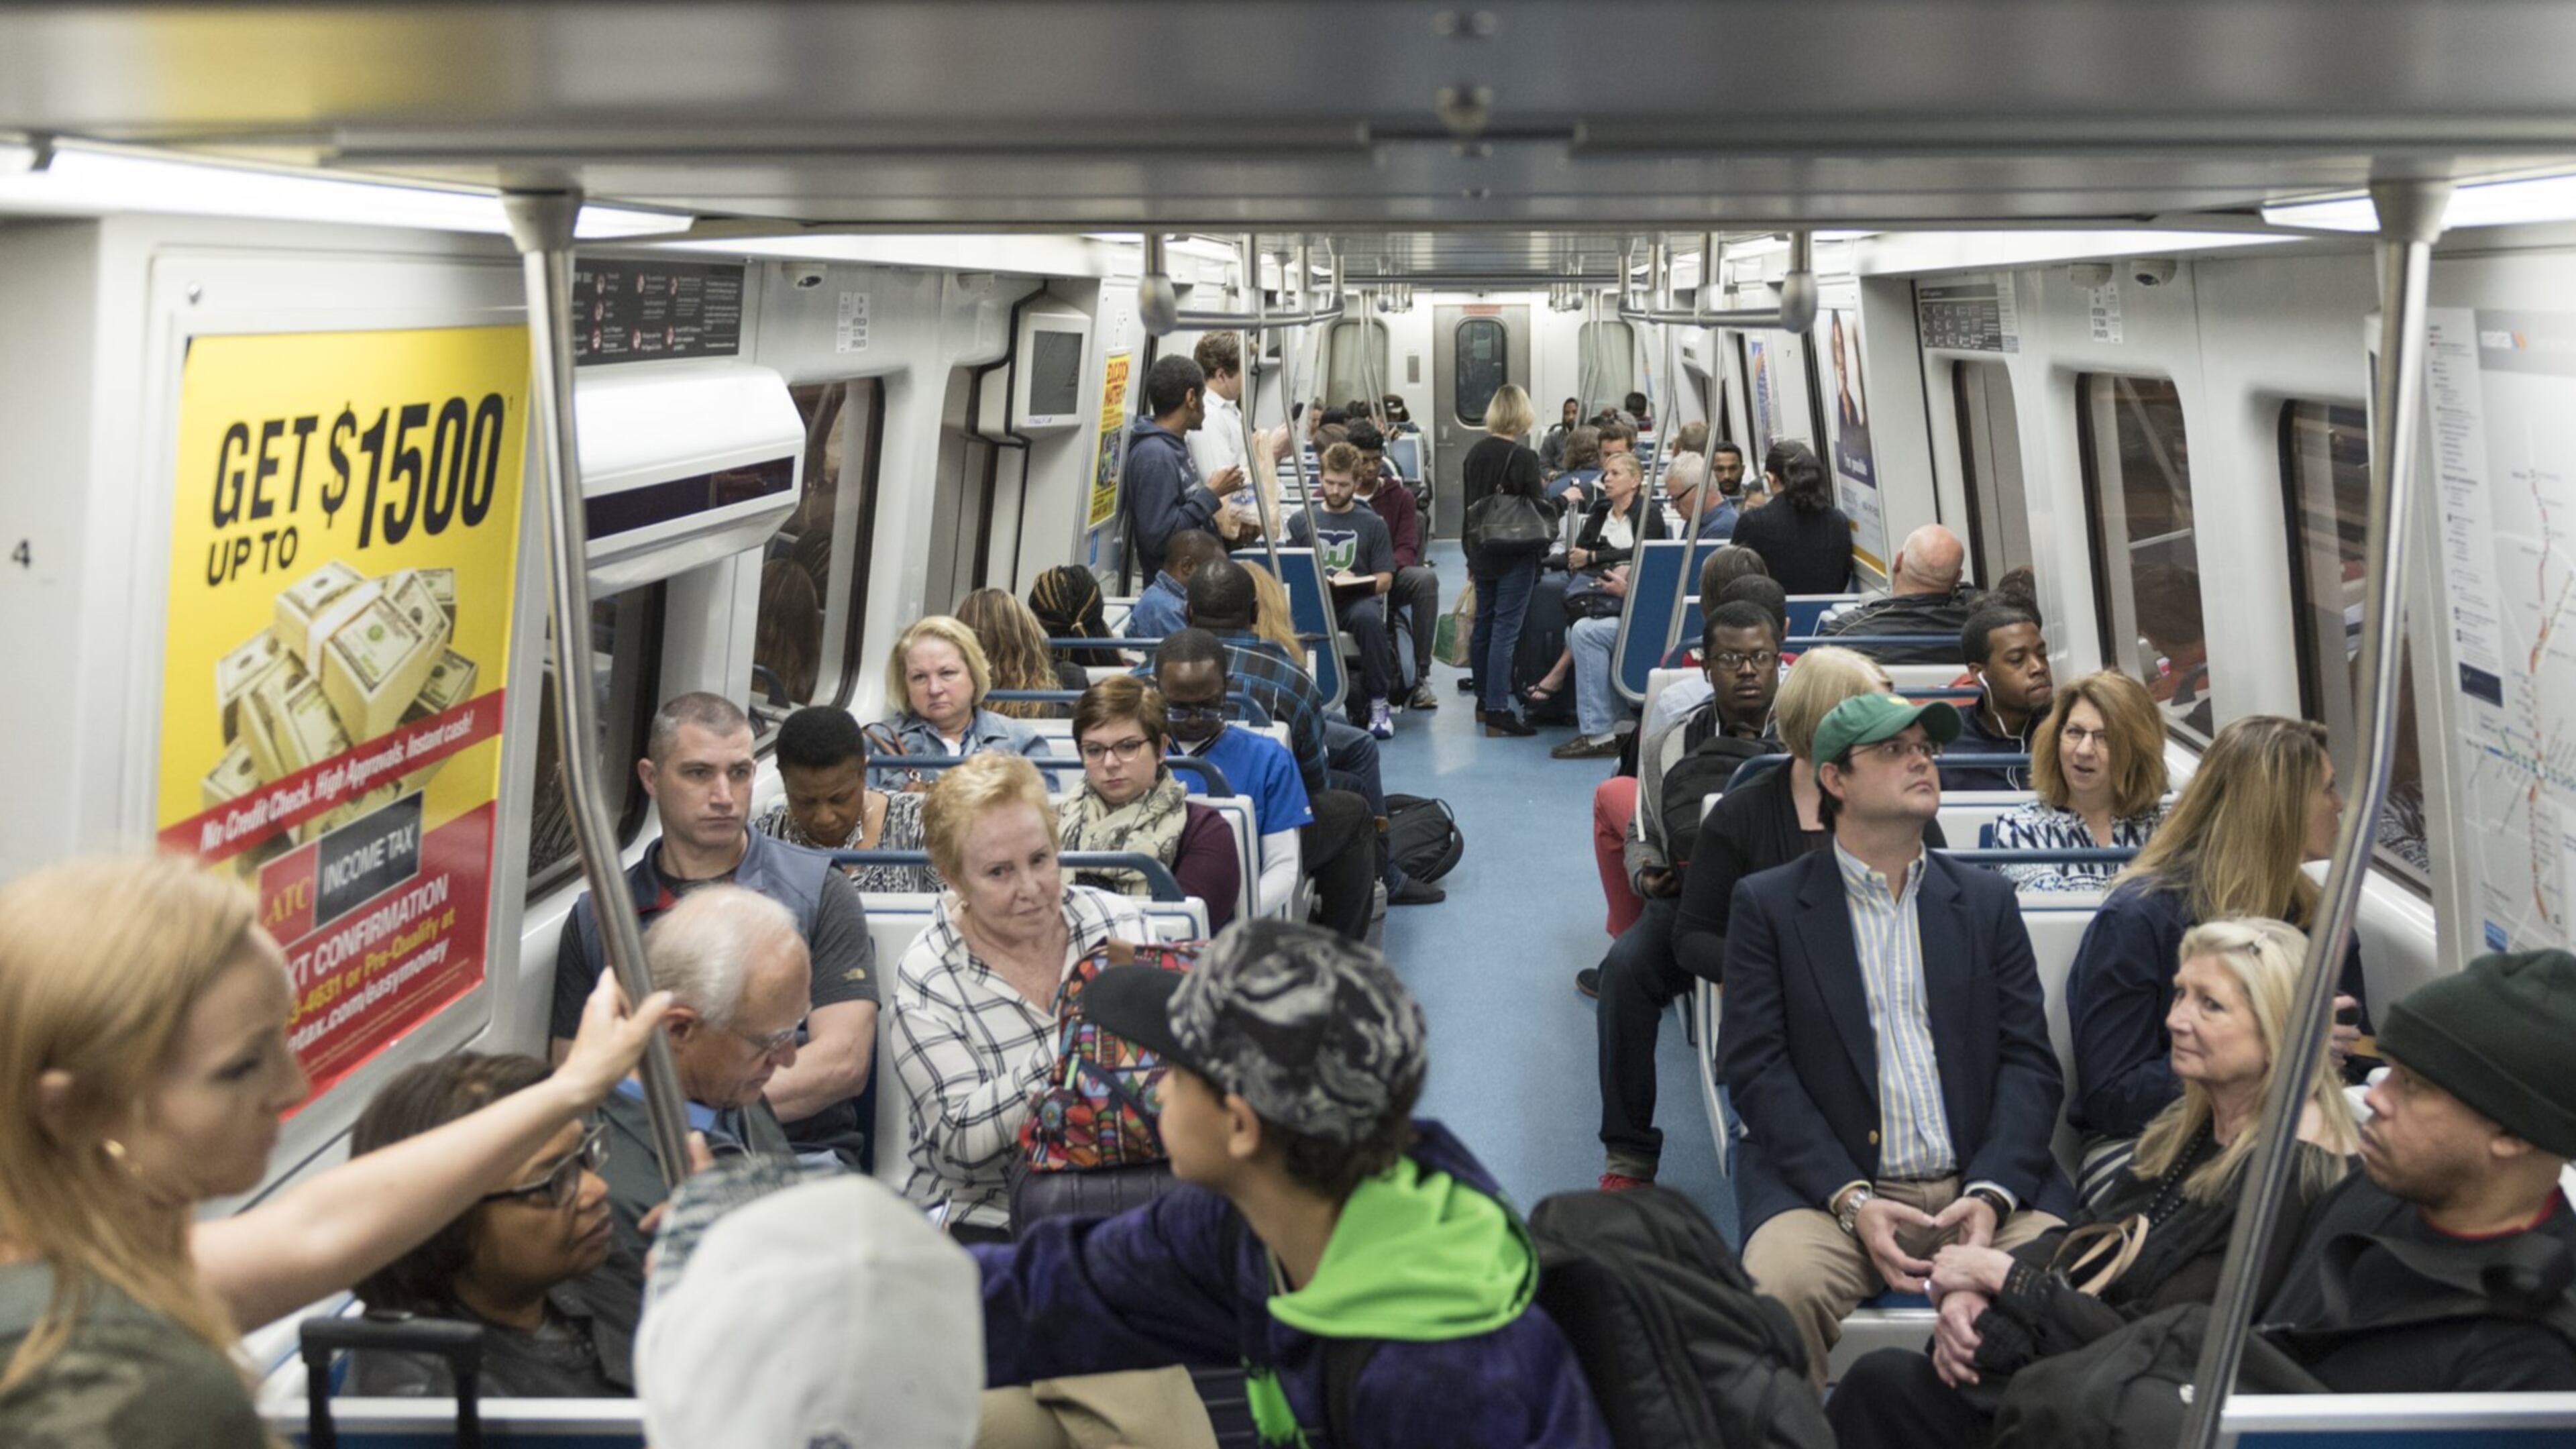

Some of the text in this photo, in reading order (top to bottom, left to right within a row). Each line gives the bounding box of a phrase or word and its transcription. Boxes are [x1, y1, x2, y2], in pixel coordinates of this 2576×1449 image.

[212, 392, 504, 550] GET $1500
[12, 539, 31, 570] 4
[207, 526, 298, 587] UP TO
[201, 818, 223, 851] No
[225, 796, 268, 840] Credit
[315, 763, 345, 800] High
[406, 724, 445, 759] Instant
[323, 823, 415, 895] INCOME TAX
[314, 873, 449, 976] CONFIRMATION
[345, 966, 362, 989] or
[364, 916, 440, 977] Pre-Qualify
[440, 907, 455, 930] at
